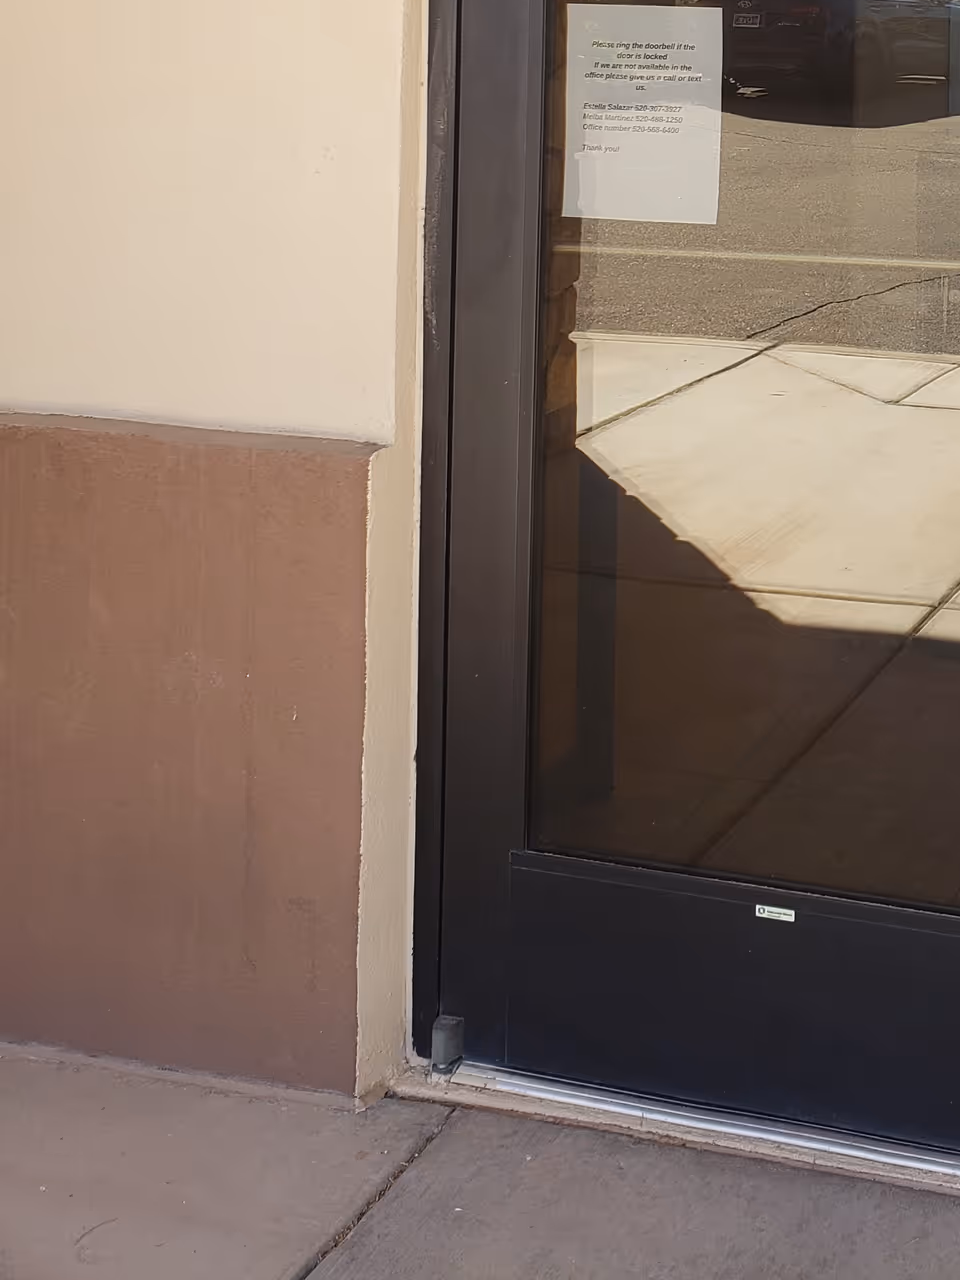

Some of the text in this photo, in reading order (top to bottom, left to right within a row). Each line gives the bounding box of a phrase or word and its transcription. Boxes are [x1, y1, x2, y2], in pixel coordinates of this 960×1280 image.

[591, 40, 696, 51] Please ring the doorbell if the
[616, 52, 668, 61] door is locked
[624, 62, 637, 70] not
[637, 63, 670, 71] available
[671, 63, 678, 71] in
[680, 64, 692, 72] the
[584, 71, 604, 79] office
[605, 72, 628, 81] please
[629, 73, 645, 81] give
[663, 73, 676, 81] call
[583, 123, 603, 131] Office
[604, 124, 631, 132] number
[582, 143, 620, 153] Thank you!
